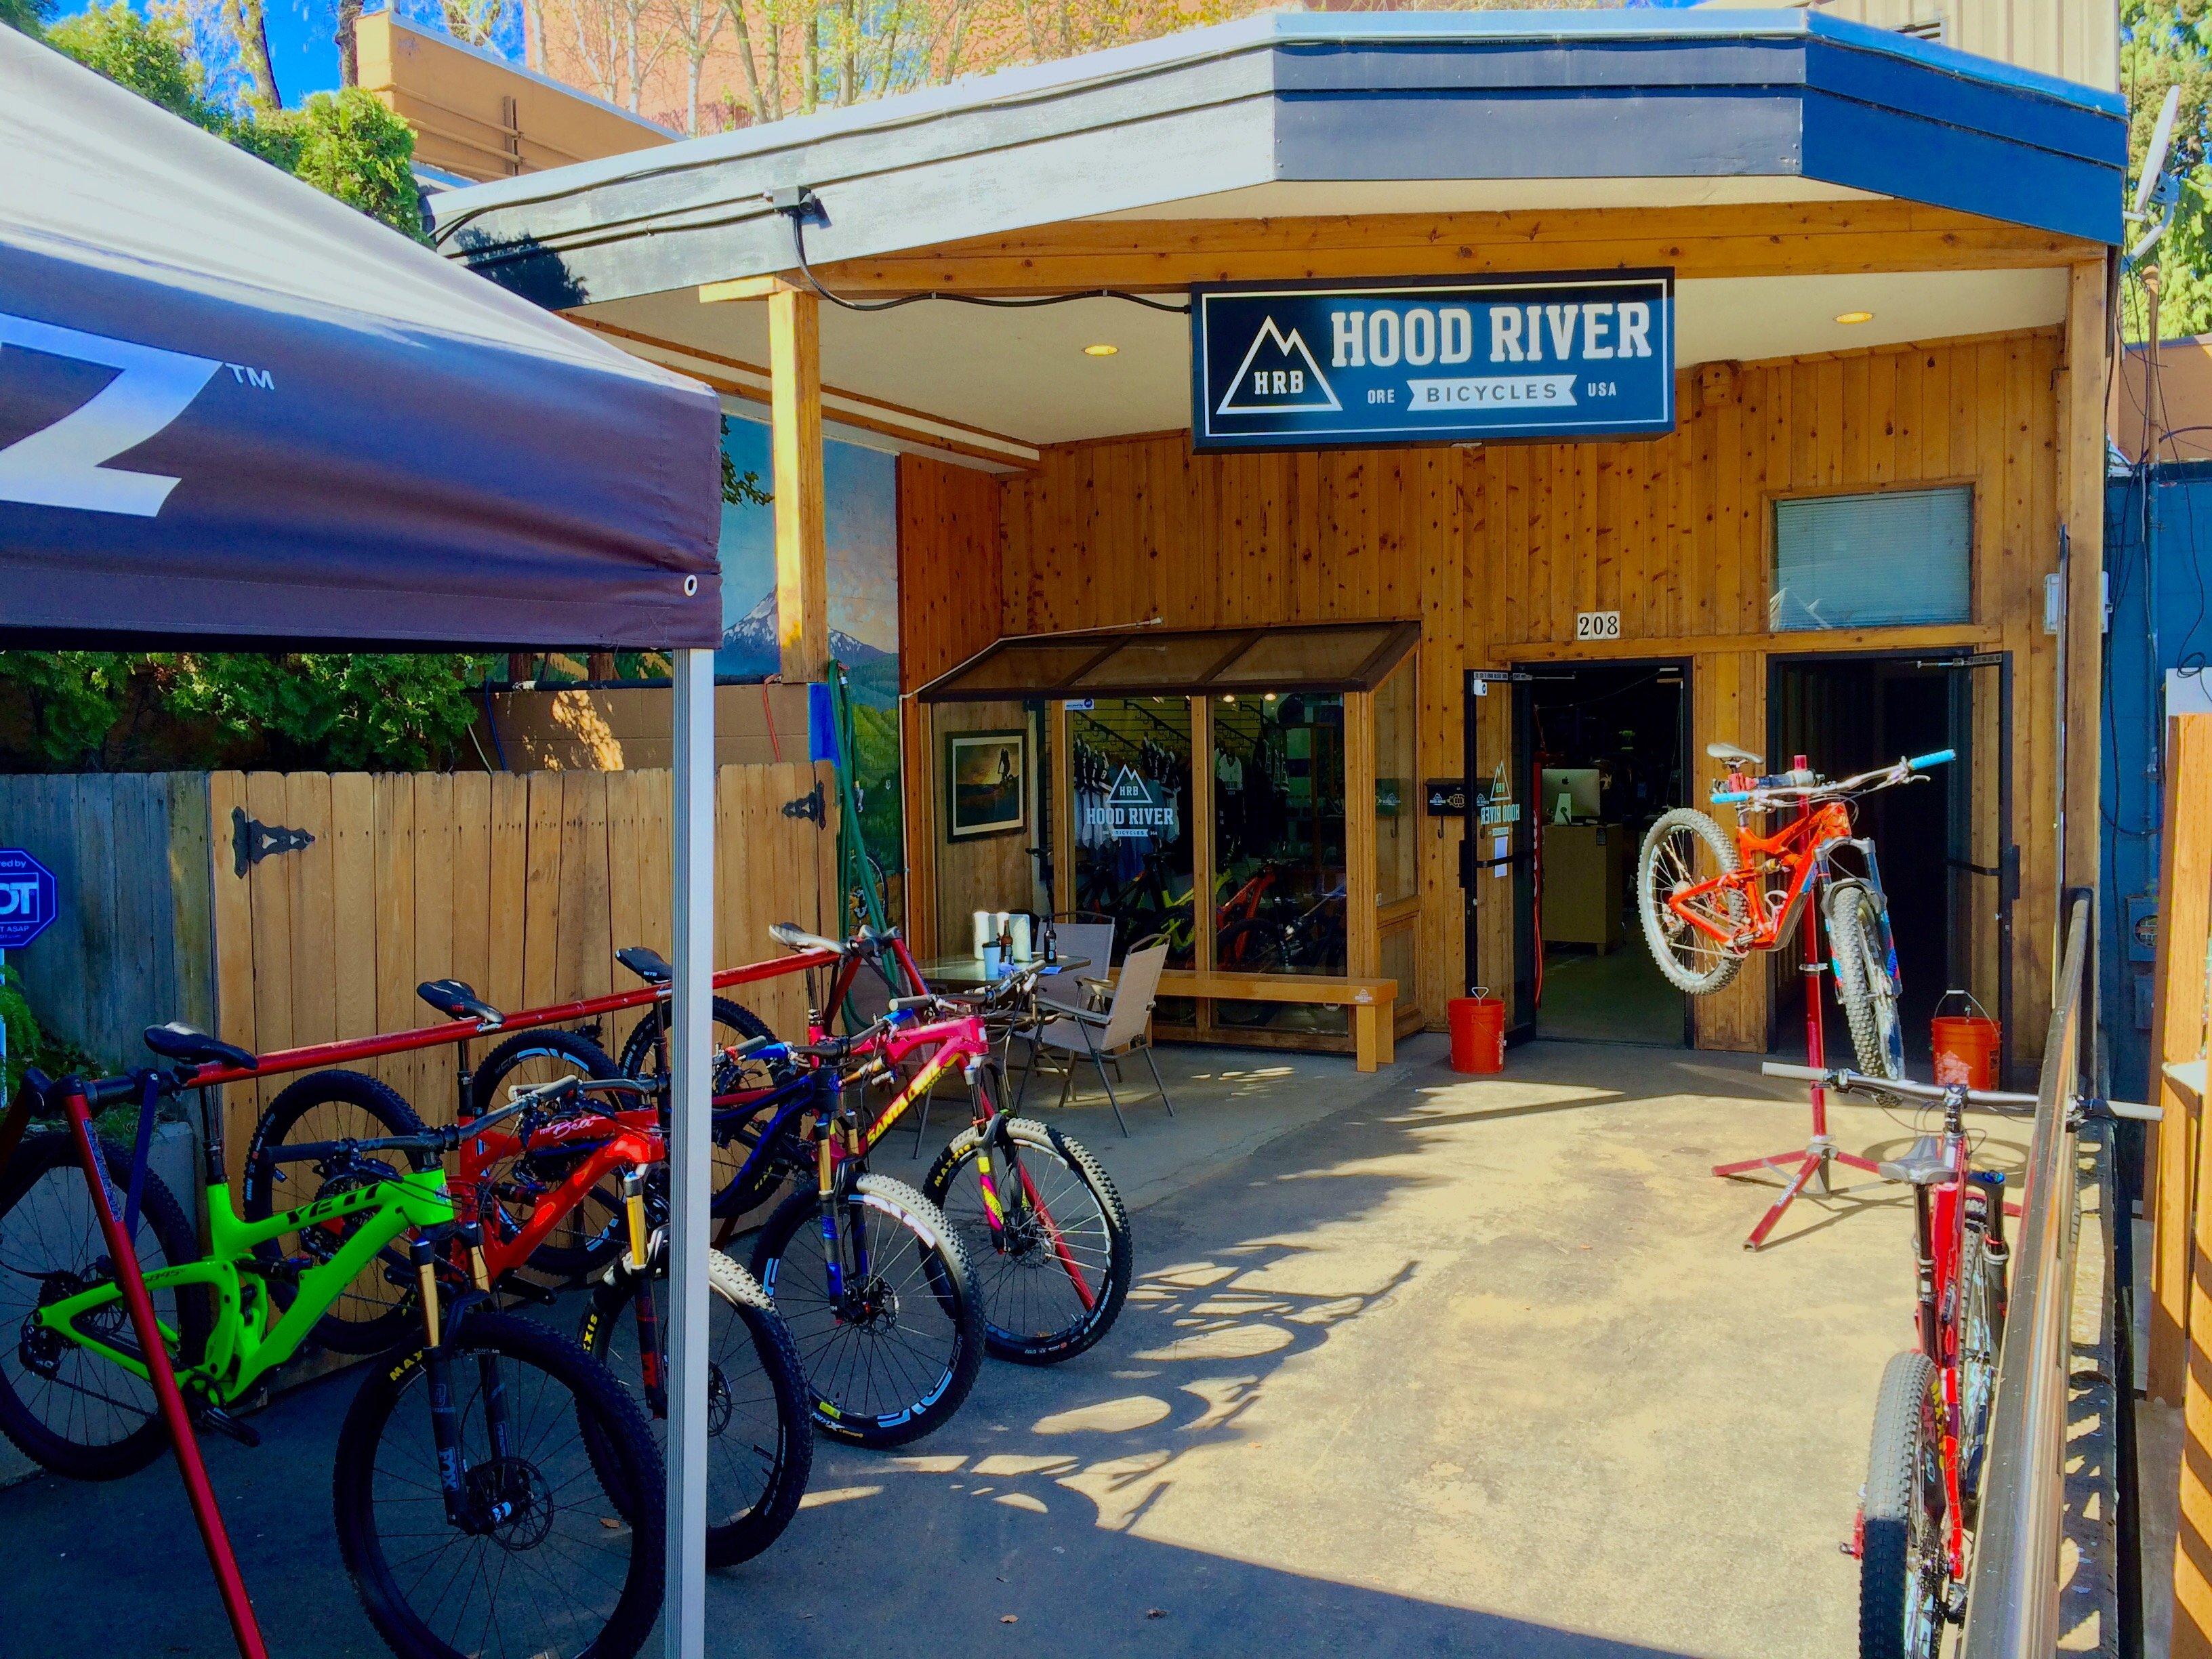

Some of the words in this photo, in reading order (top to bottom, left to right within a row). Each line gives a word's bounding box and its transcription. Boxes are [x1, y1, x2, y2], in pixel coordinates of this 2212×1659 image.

[1331, 308, 1473, 367] HOOD
[1489, 302, 1652, 363] RIVER
[1254, 370, 1305, 394] HRB
[1367, 389, 1395, 405] ORE
[1427, 384, 1557, 403] BICYCLES
[1588, 382, 1617, 396] USA
[1579, 615, 1618, 636] 208
[1120, 785, 1139, 796] HRB
[1086, 808, 1124, 825] HOOD
[1128, 808, 1174, 825] RIVER
[935, 1144, 970, 1187] MAXXIS
[287, 1182, 380, 1225] YETI
